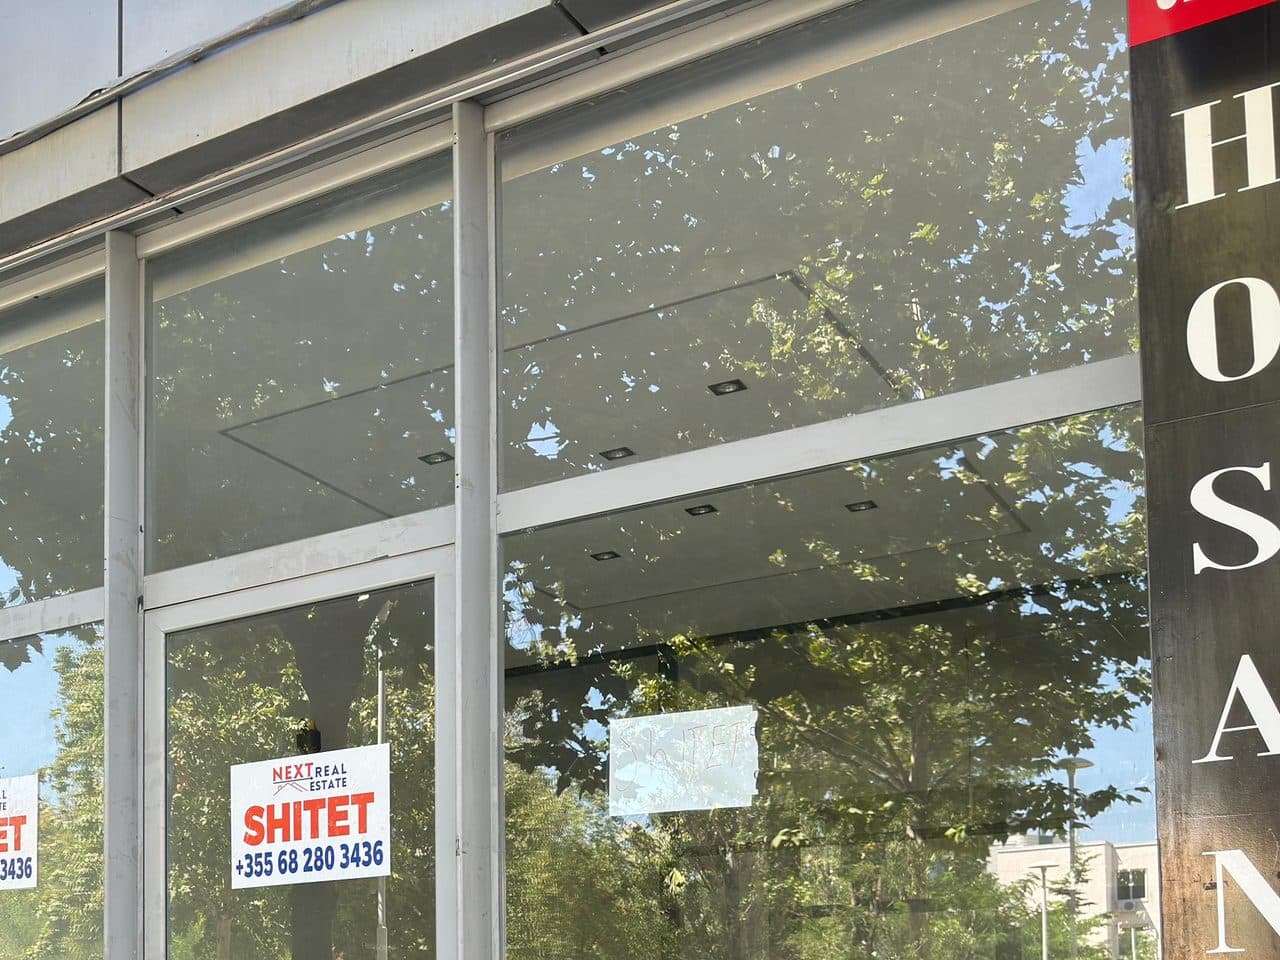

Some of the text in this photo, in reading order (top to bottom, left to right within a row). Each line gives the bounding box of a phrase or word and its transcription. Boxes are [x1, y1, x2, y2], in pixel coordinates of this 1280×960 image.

[272, 762, 347, 782] NEXT REAL
[310, 777, 347, 792] ESTATE
[243, 792, 375, 846] SHITET
[0, 856, 32, 881] 3436
[236, 840, 384, 879] +355 68 280 3436
